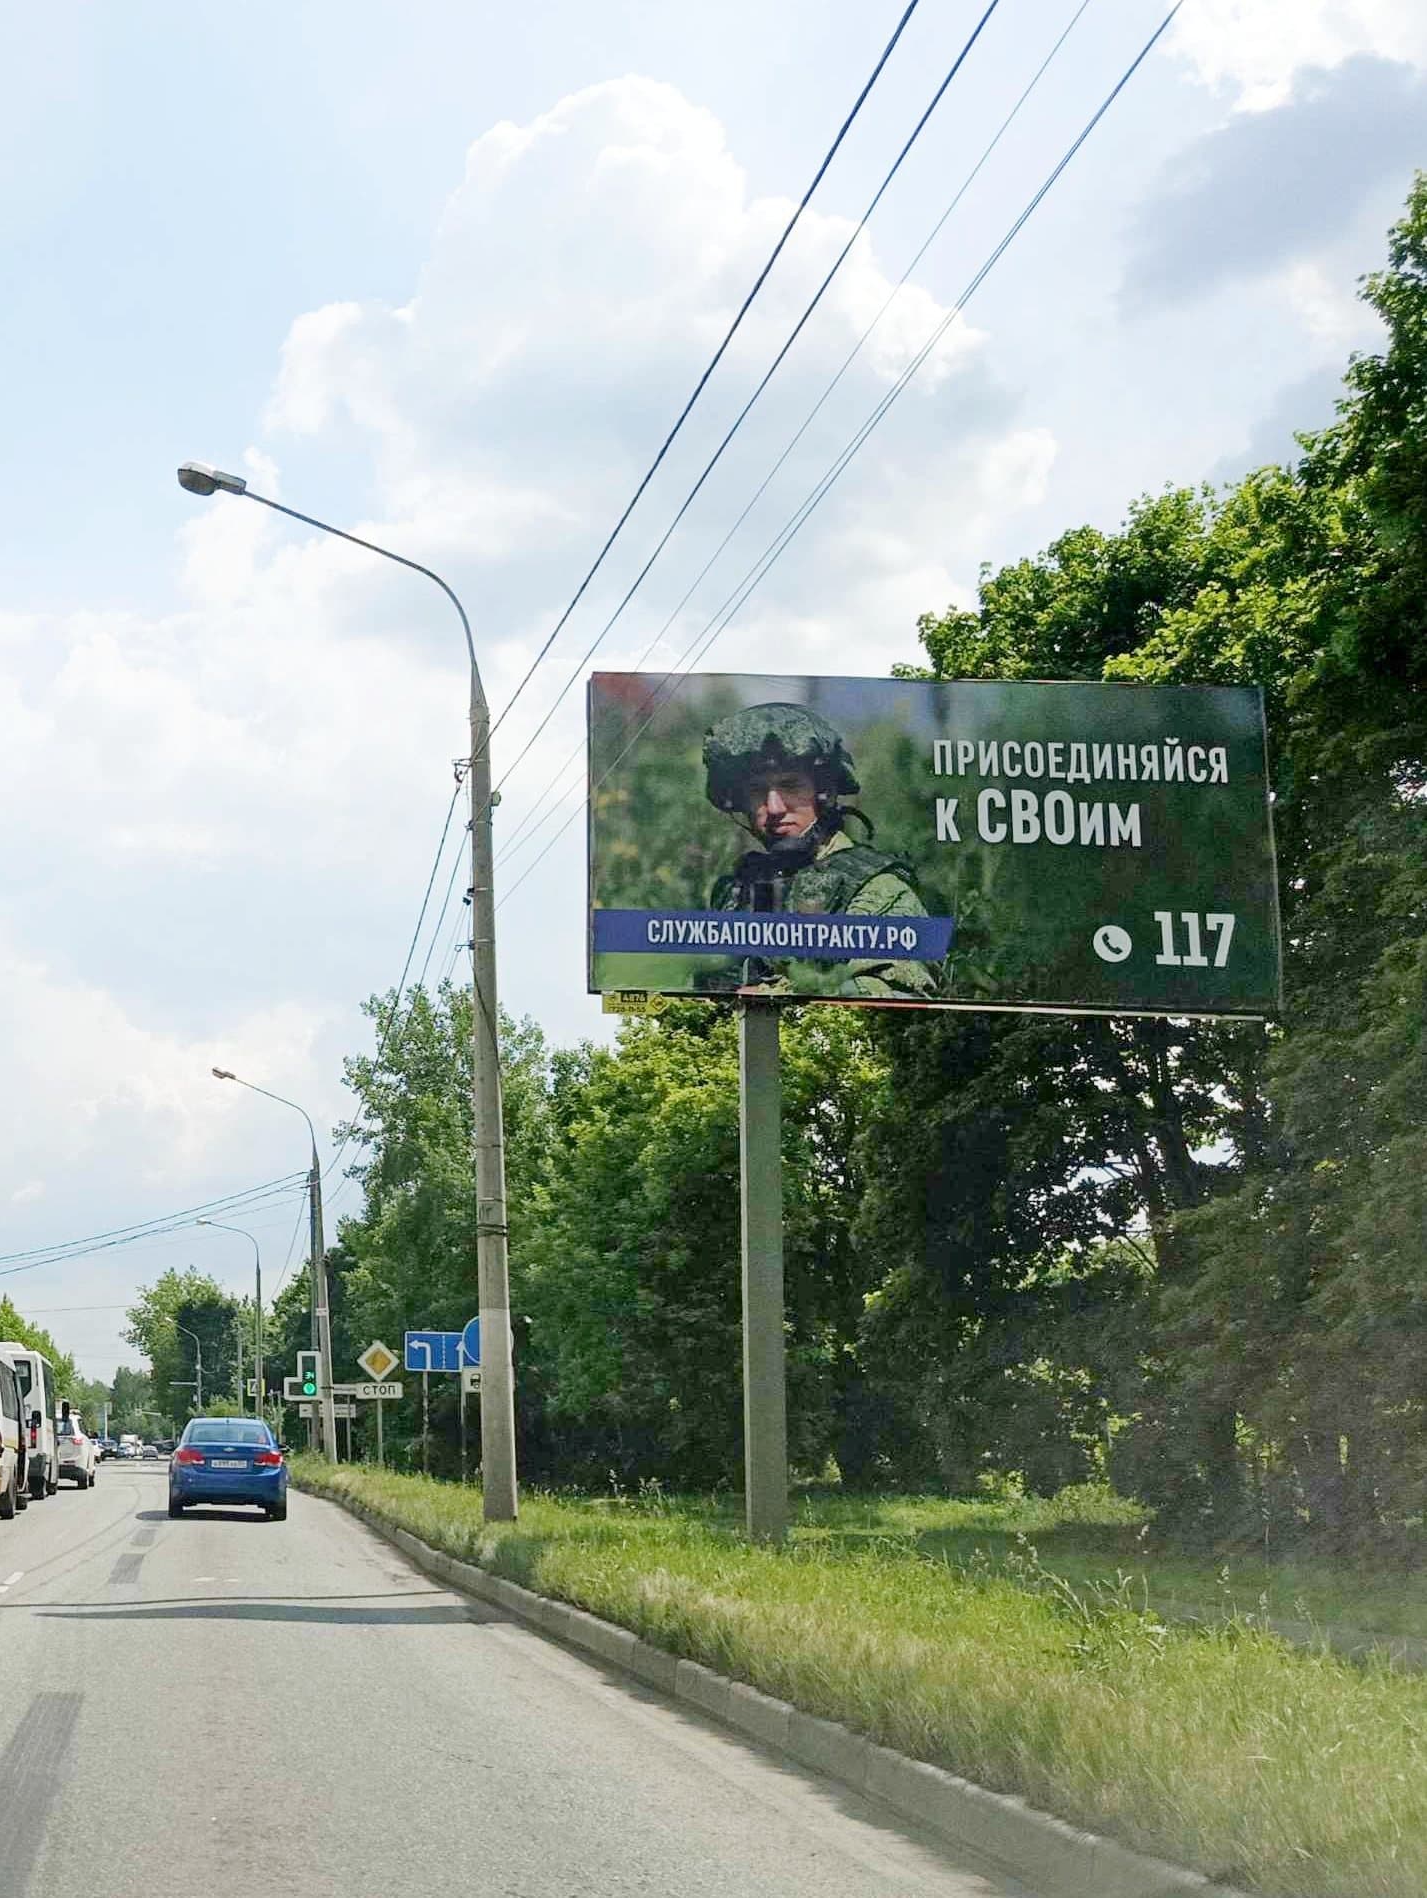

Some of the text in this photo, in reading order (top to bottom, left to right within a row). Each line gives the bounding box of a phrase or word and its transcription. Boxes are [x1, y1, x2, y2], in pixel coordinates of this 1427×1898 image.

[933, 737, 1229, 784] ПРИСОЕДИНЯЙСЯ
[647, 919, 918, 951] СЛУЖБАПОКОНТРАКТУ.РФ
[1154, 911, 1235, 967] 117
[363, 1385, 396, 1396] СТОП
